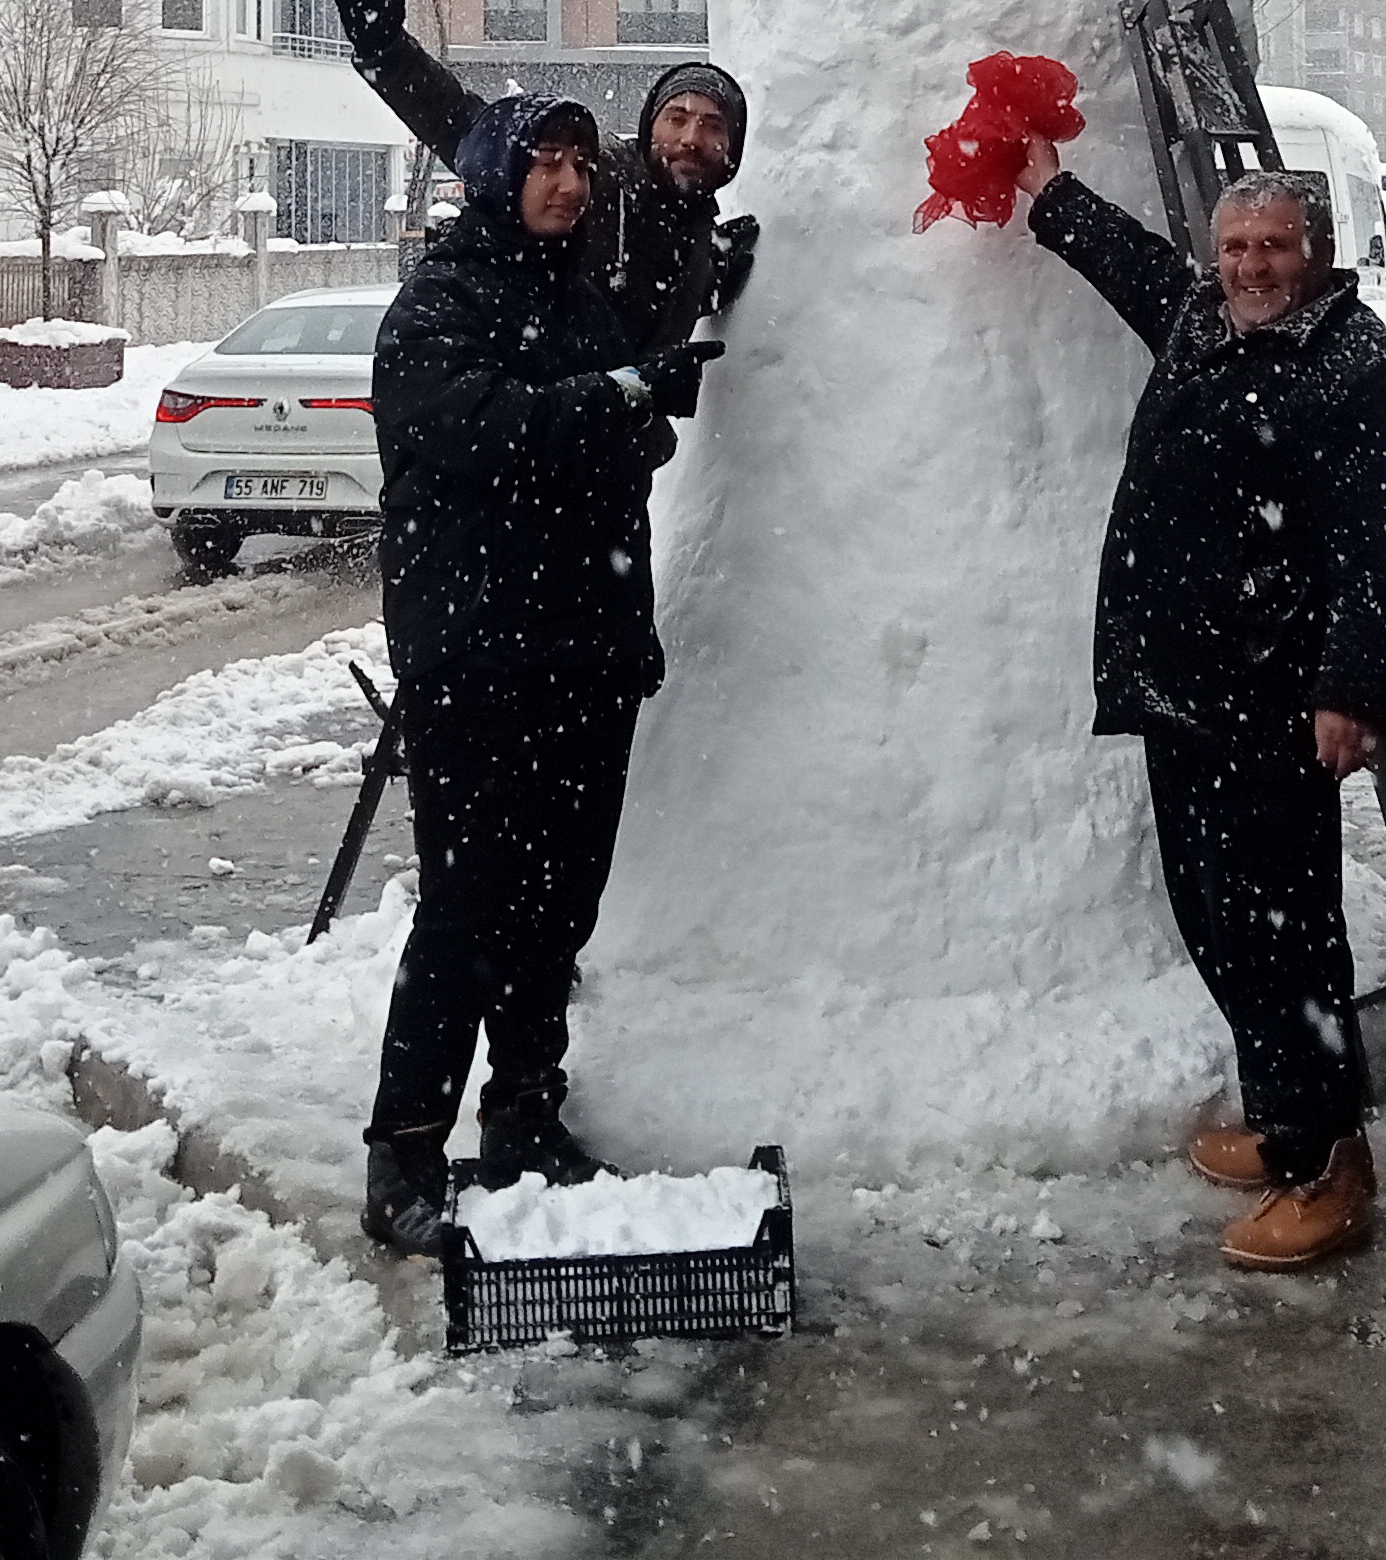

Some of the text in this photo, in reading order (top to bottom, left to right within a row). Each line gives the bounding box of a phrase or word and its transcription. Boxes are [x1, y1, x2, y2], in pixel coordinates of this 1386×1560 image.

[235, 479, 325, 497] 55 ANF 719
